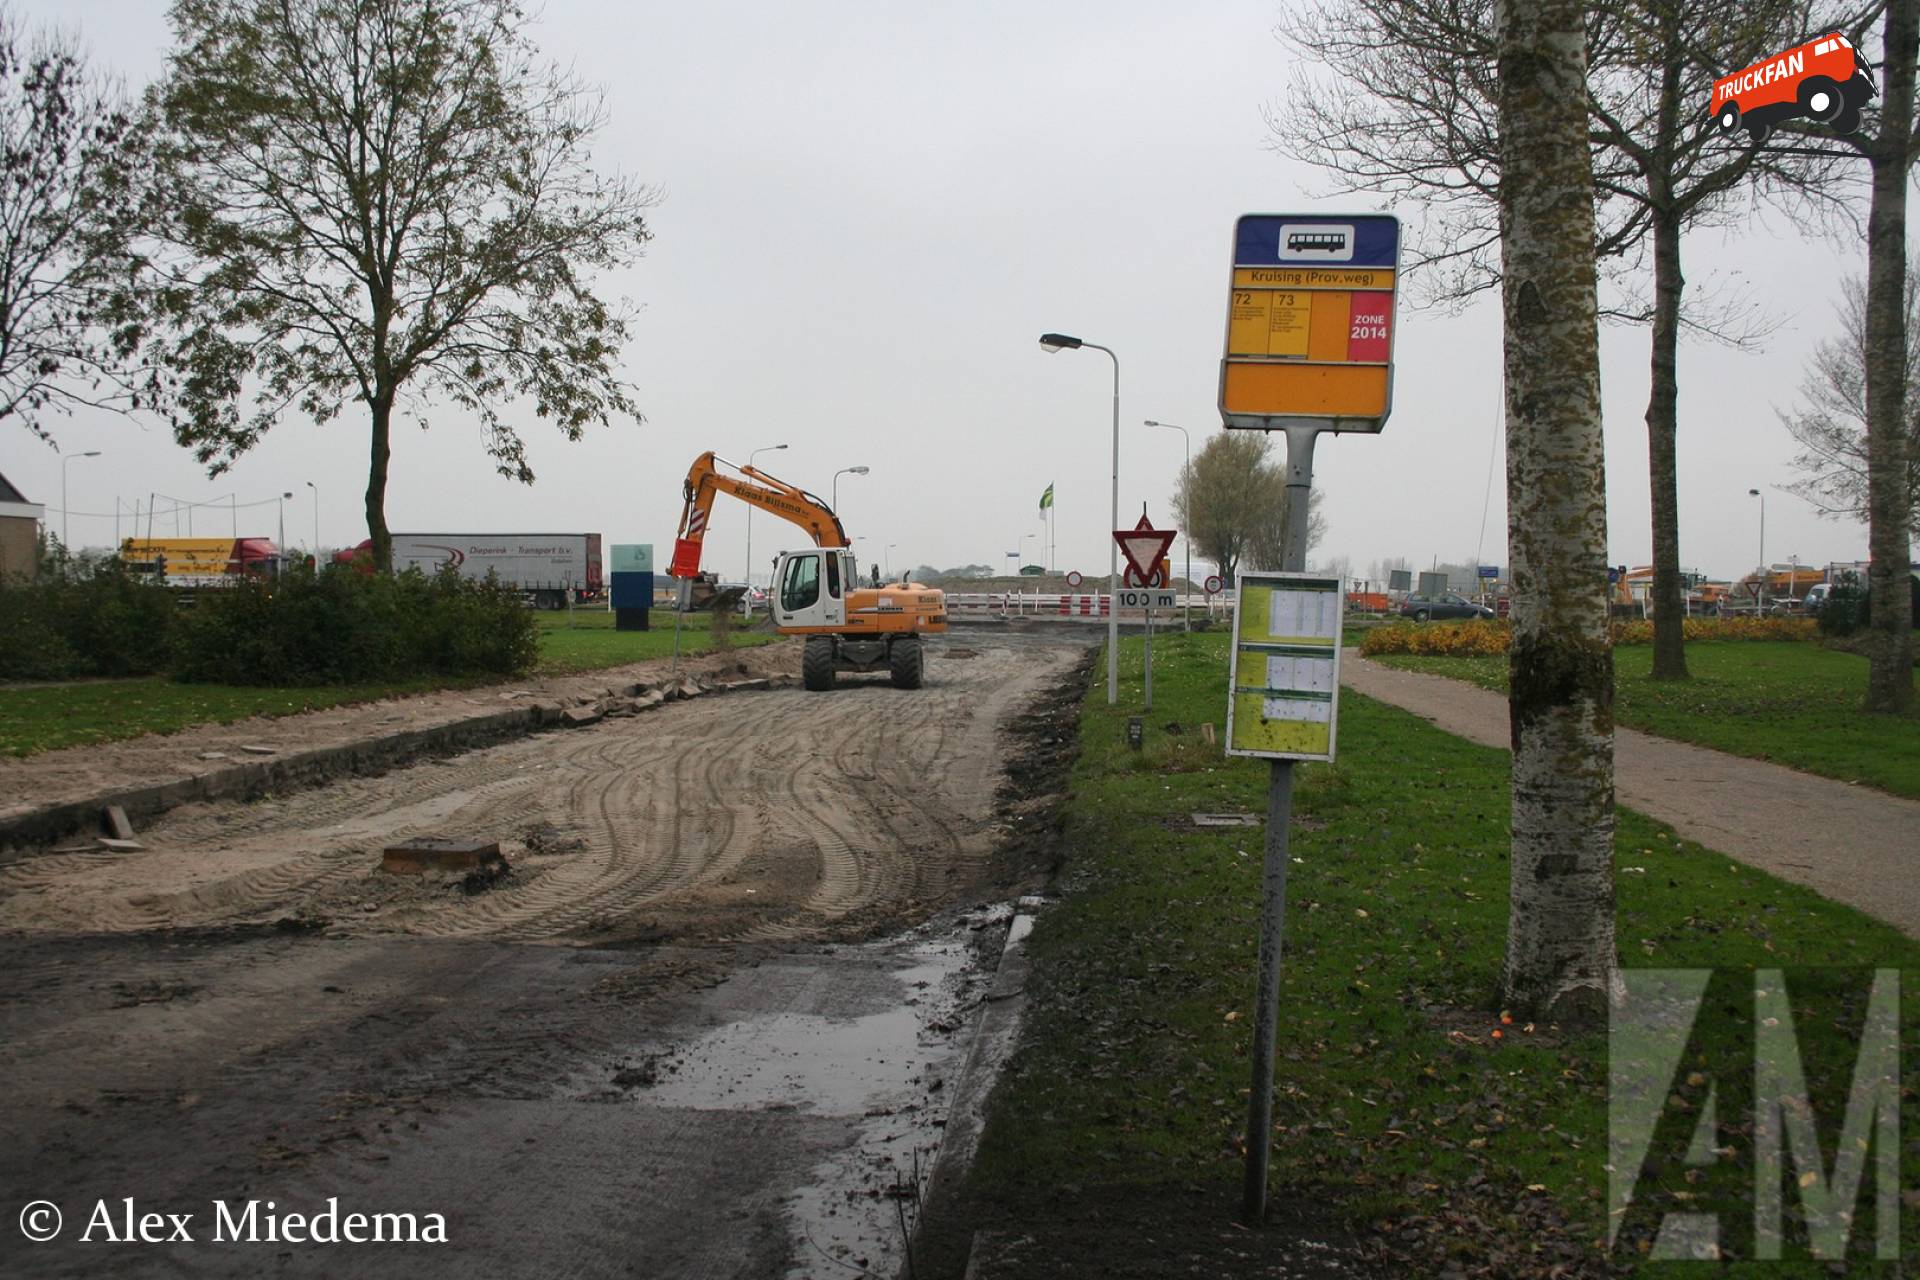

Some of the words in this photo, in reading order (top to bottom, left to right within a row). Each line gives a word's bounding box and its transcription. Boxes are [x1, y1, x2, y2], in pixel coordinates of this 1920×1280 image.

[1250, 270, 1302, 285] Kruising
[1305, 270, 1375, 287] (Prov.weg)
[1234, 293, 1251, 305] 72
[1279, 294, 1295, 306] 73
[1354, 315, 1385, 325] ZONE
[1350, 327, 1388, 339] 2014
[518, 545, 556, 557] Transport
[1119, 592, 1150, 607] 100
[1158, 595, 1173, 606] m
